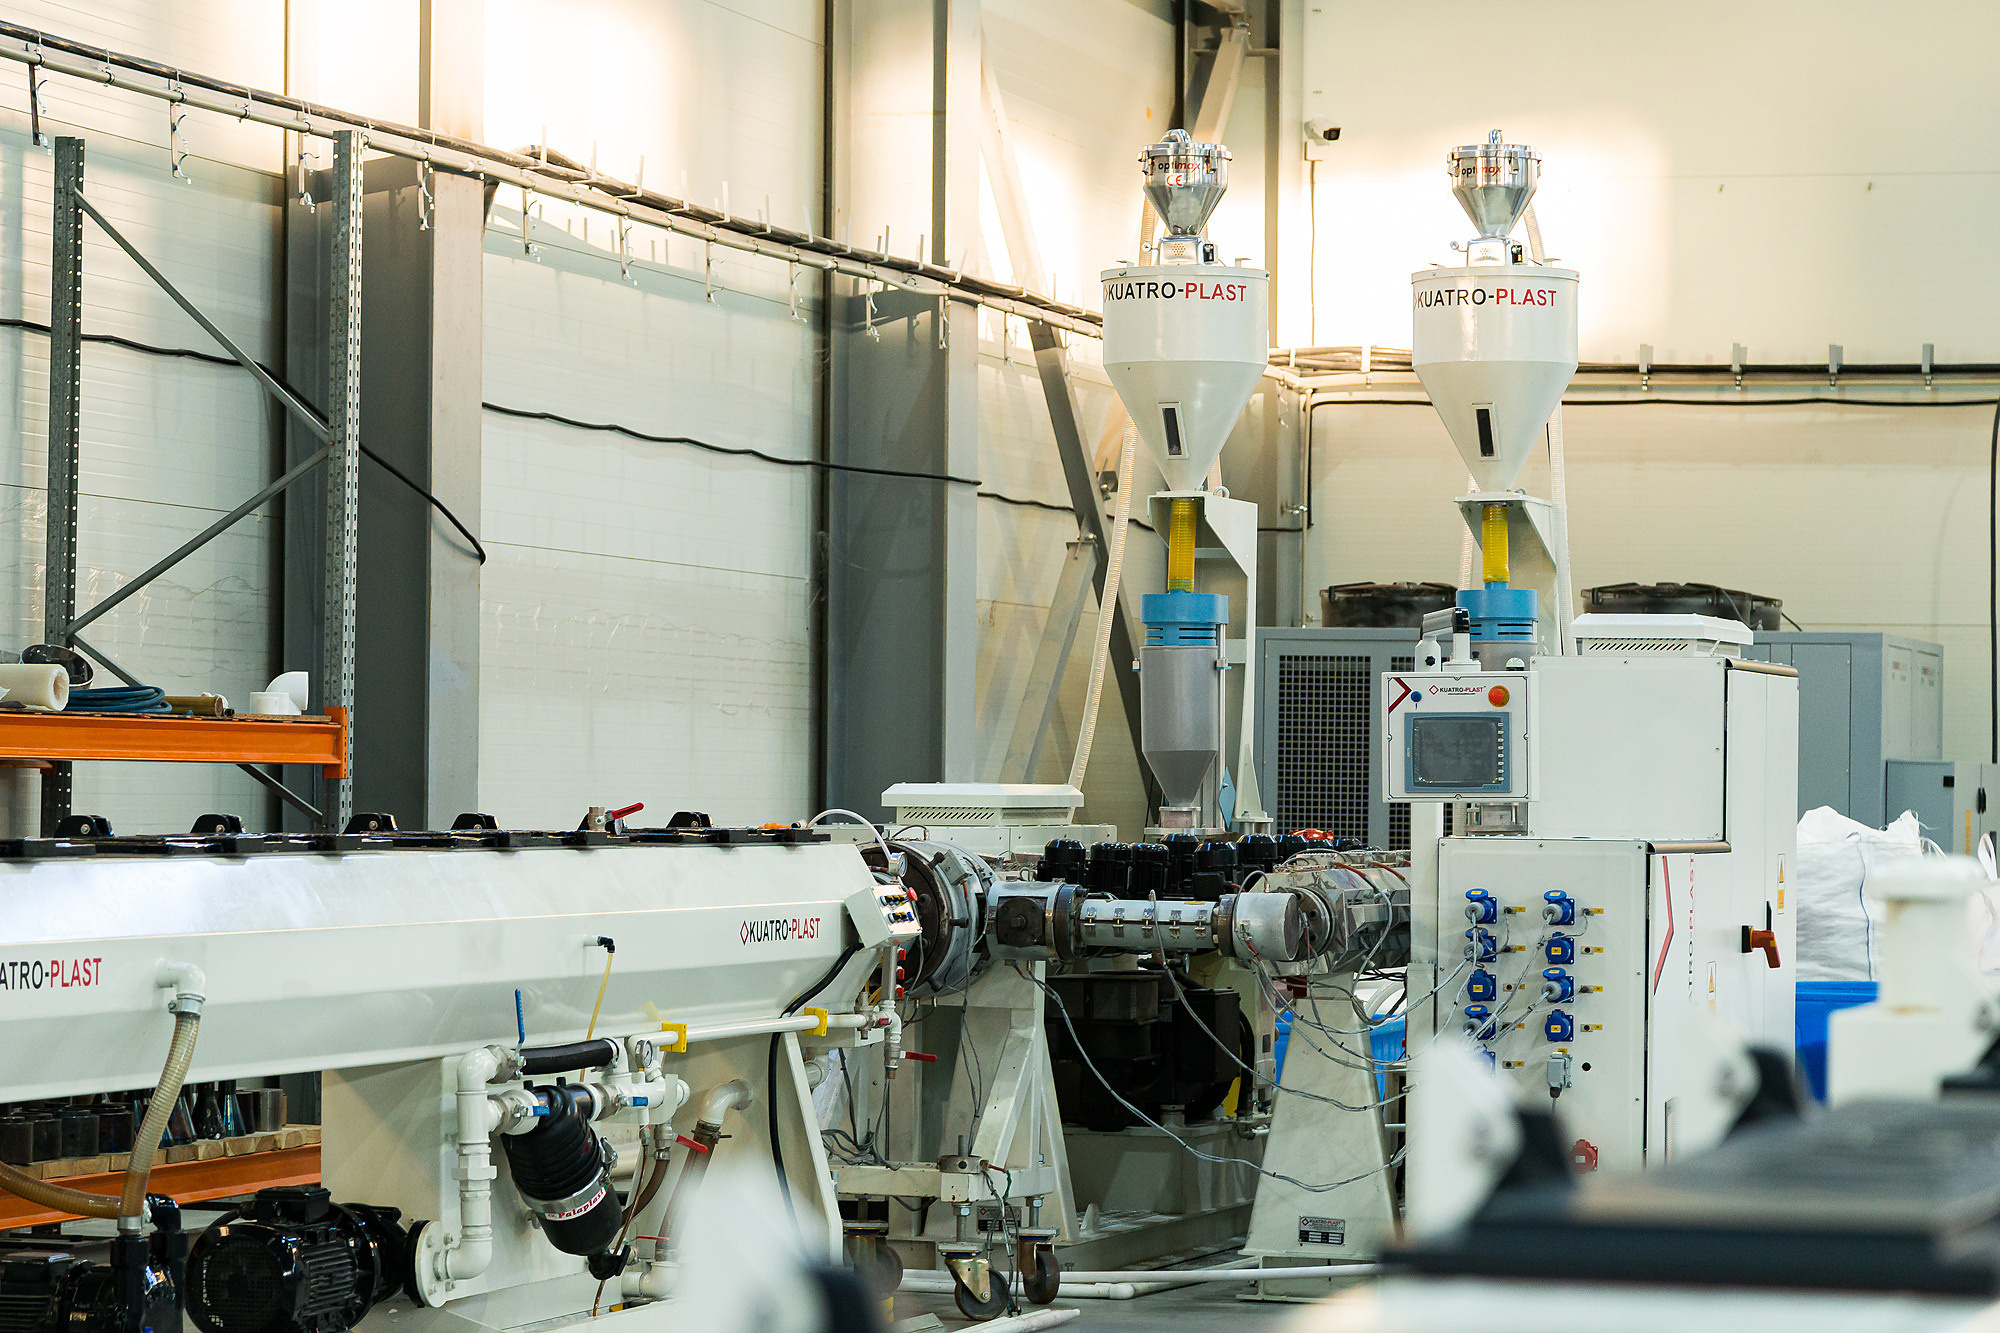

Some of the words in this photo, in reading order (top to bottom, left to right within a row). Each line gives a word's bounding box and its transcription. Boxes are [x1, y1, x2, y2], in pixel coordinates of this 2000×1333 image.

[1166, 174, 1182, 187] CE
[1108, 282, 1247, 302] KUATRO-PLAST
[1417, 288, 1557, 308] KUATRO-PLAST
[749, 917, 821, 943] KUATRO-PLAST
[558, 1188, 604, 1218] Palaplast
